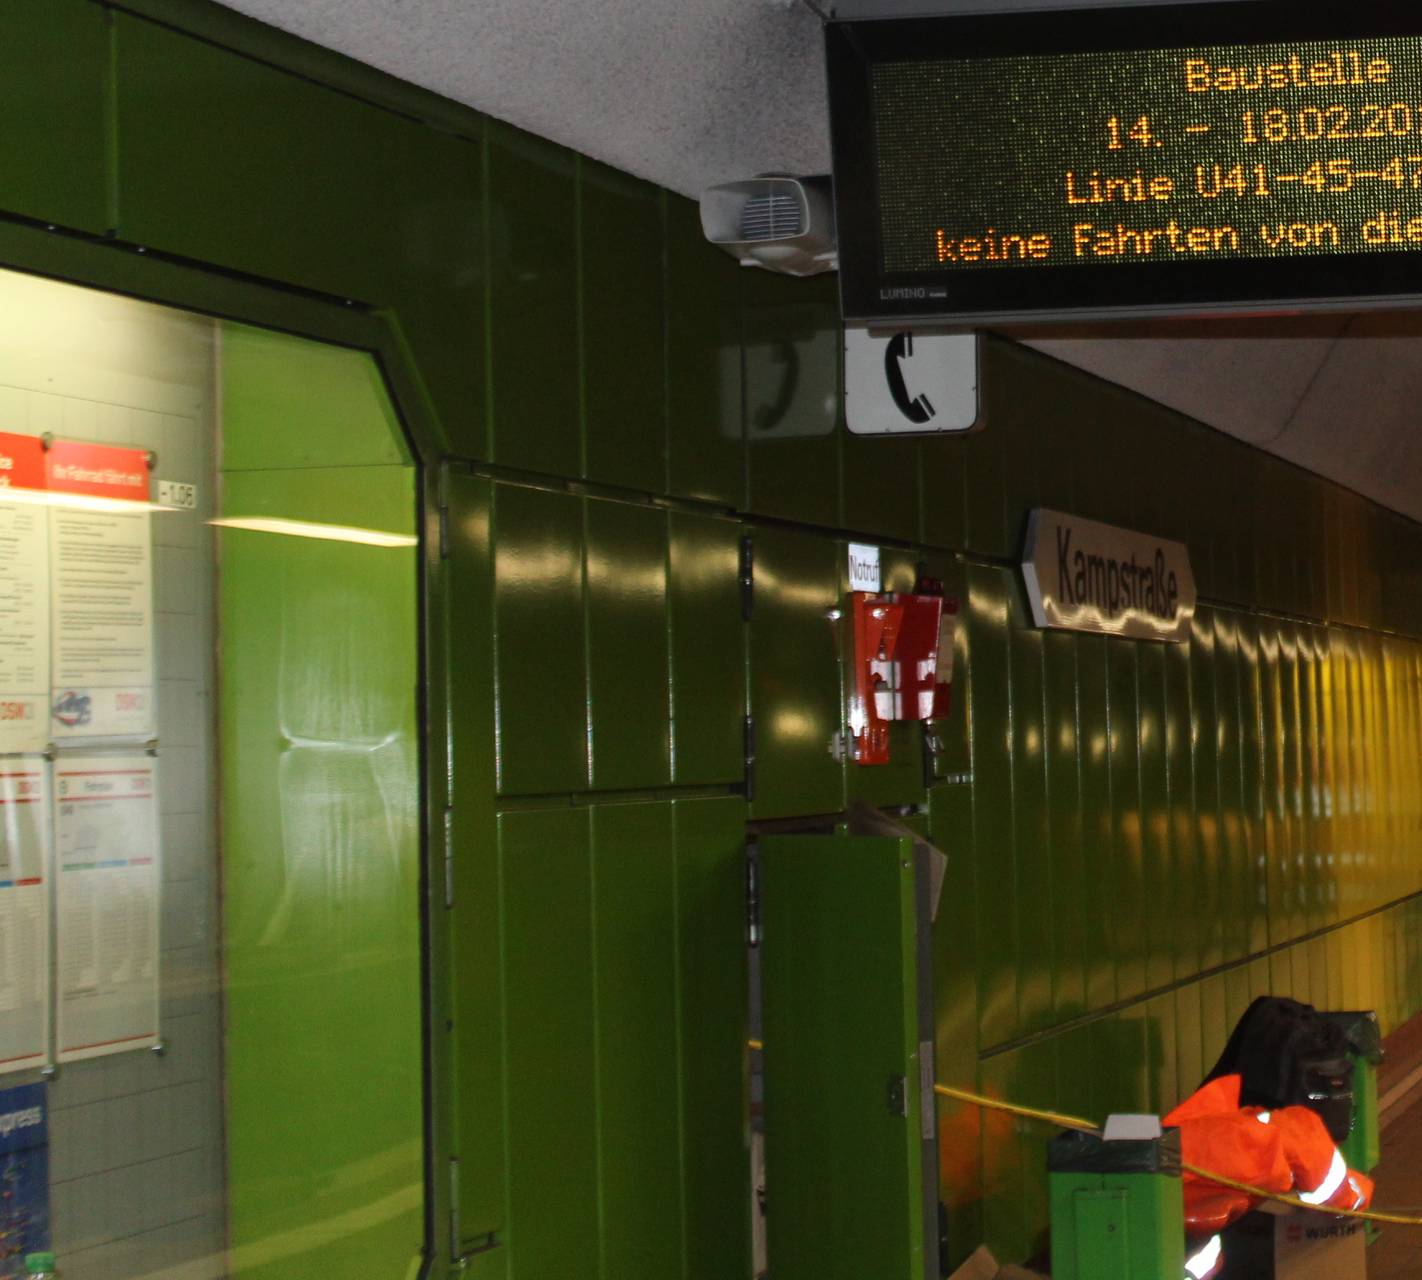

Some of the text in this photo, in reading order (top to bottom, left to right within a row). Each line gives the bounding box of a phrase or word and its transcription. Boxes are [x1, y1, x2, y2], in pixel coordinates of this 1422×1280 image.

[1185, 50, 1391, 92] Baustelle
[1107, 115, 1163, 149] 14.
[1066, 169, 1175, 204] Linie
[934, 227, 1051, 262] keine
[1074, 220, 1240, 256] Fahrten
[1260, 221, 1340, 248] von
[880, 287, 925, 299] LUMINO
[849, 555, 880, 582] Notruf
[1057, 525, 1178, 619] Kampstraße
